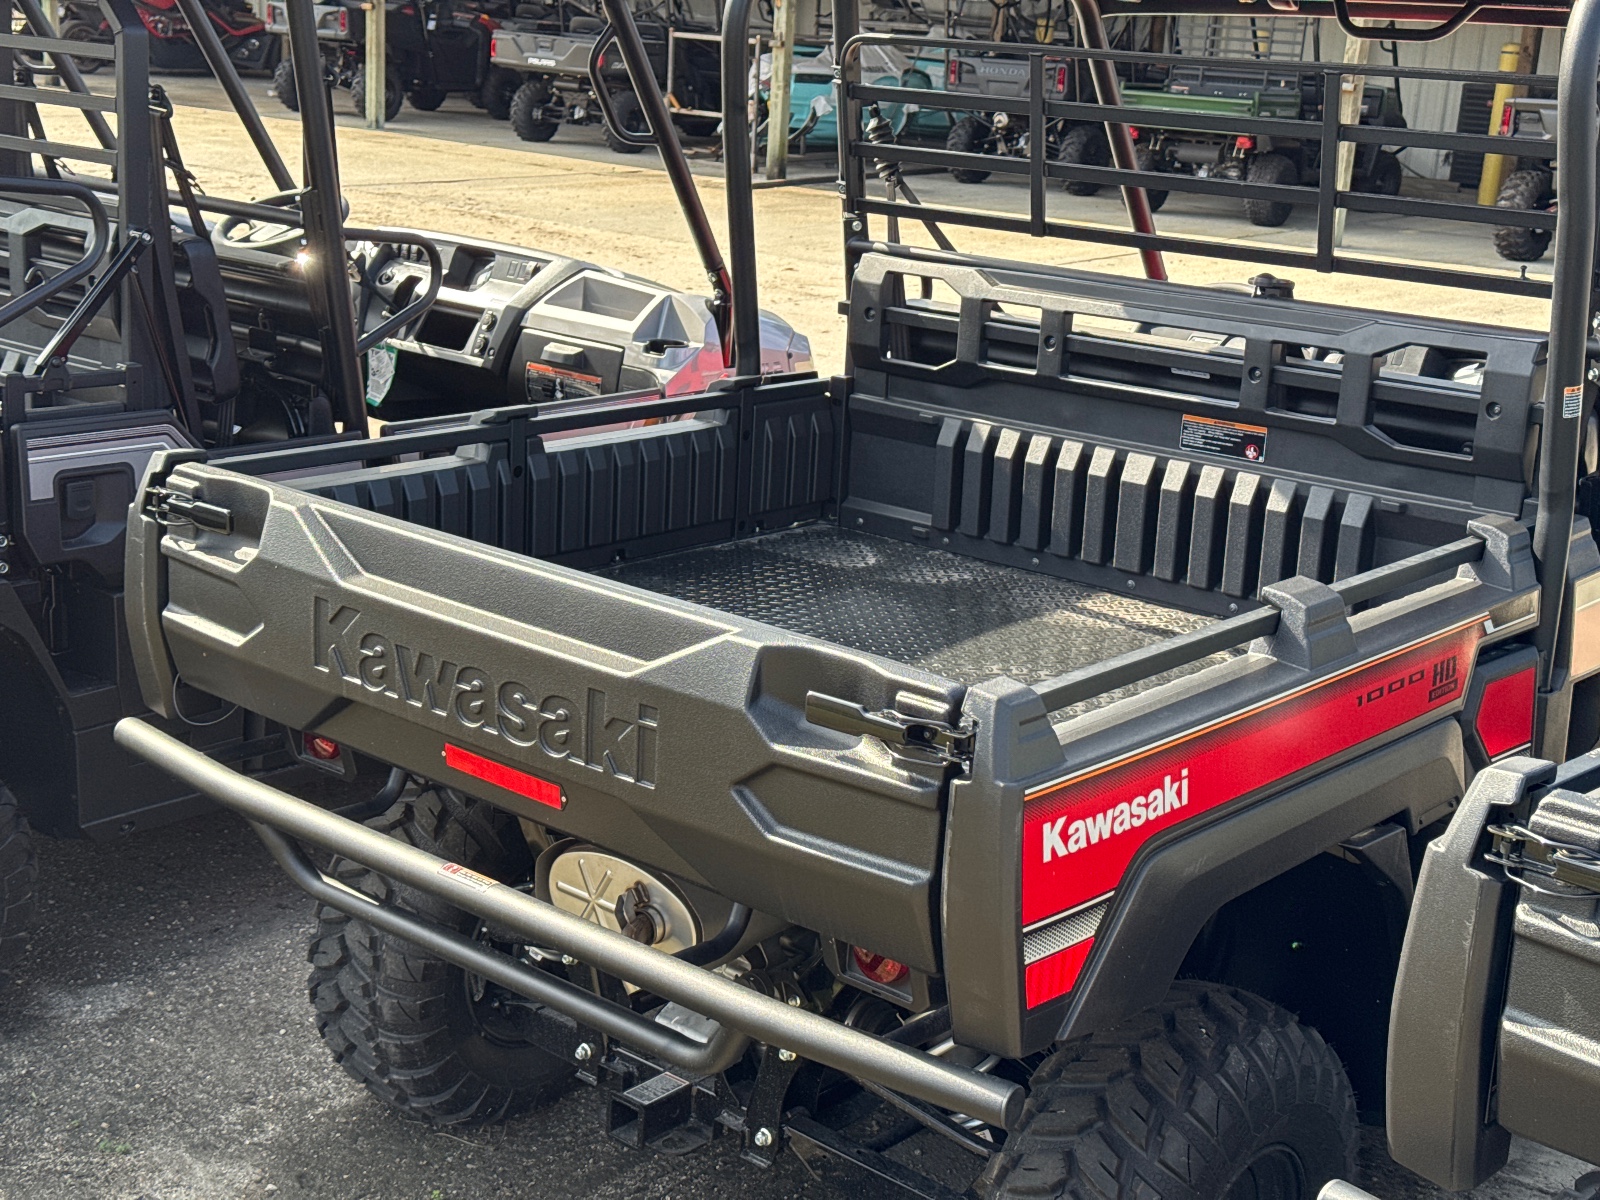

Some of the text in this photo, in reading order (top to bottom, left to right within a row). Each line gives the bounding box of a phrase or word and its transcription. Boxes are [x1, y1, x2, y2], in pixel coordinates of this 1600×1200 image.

[980, 66, 1026, 76] HONDA
[1356, 669, 1425, 707] 1000
[1432, 656, 1457, 687] HD
[313, 596, 659, 789] Kawasaki
[1430, 681, 1457, 700] EDITION
[1043, 767, 1189, 863] Kawasaki
